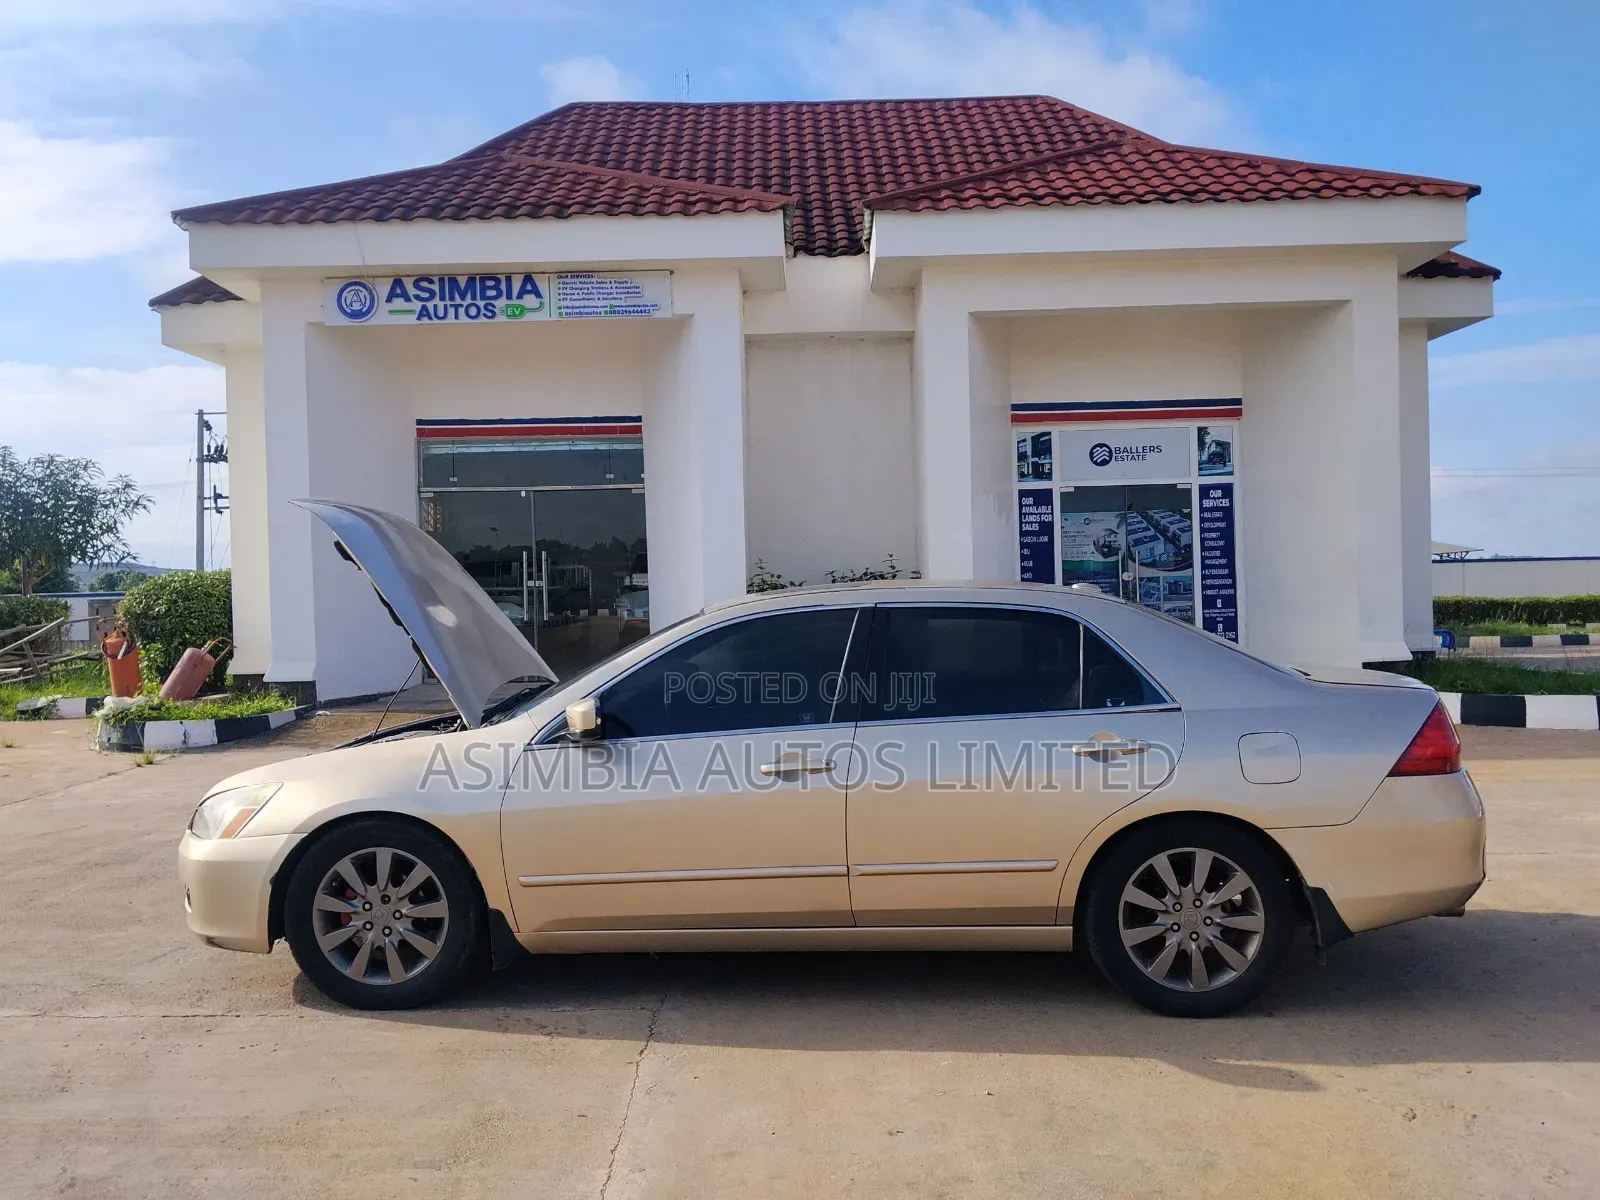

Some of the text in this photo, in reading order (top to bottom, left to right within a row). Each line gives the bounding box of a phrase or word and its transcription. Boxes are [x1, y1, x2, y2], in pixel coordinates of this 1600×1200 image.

[385, 274, 544, 303] ASIMBIA
[415, 302, 521, 321] AUTOS EV
[1114, 445, 1163, 455] BALLERS
[1114, 454, 1147, 462] ESTATE
[1209, 489, 1222, 498] OUR
[1021, 497, 1034, 505] OUR
[1202, 498, 1230, 508] SERVICES
[1021, 505, 1052, 514] AVAILABLE
[1021, 514, 1053, 522] LANDS FOR
[1022, 523, 1039, 531] SALES
